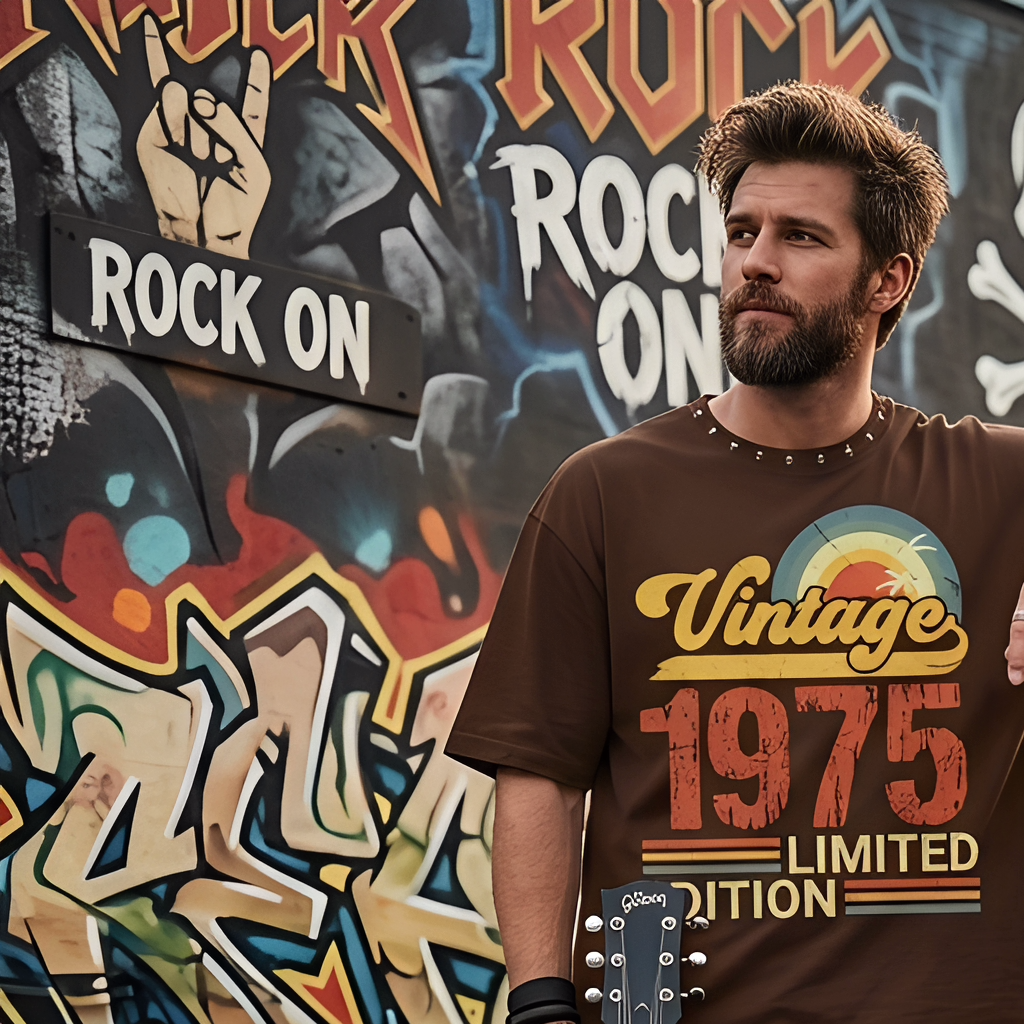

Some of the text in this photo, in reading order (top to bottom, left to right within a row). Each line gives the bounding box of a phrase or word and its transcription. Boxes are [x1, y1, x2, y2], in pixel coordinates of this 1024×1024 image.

[489, 144, 724, 302] ROC
[87, 238, 371, 395] ROCK ON
[596, 280, 724, 410] ON
[635, 555, 969, 674] Vintage
[640, 683, 968, 830] 1975
[671, 879, 837, 920] DITION
[788, 832, 980, 874] LIMITED
